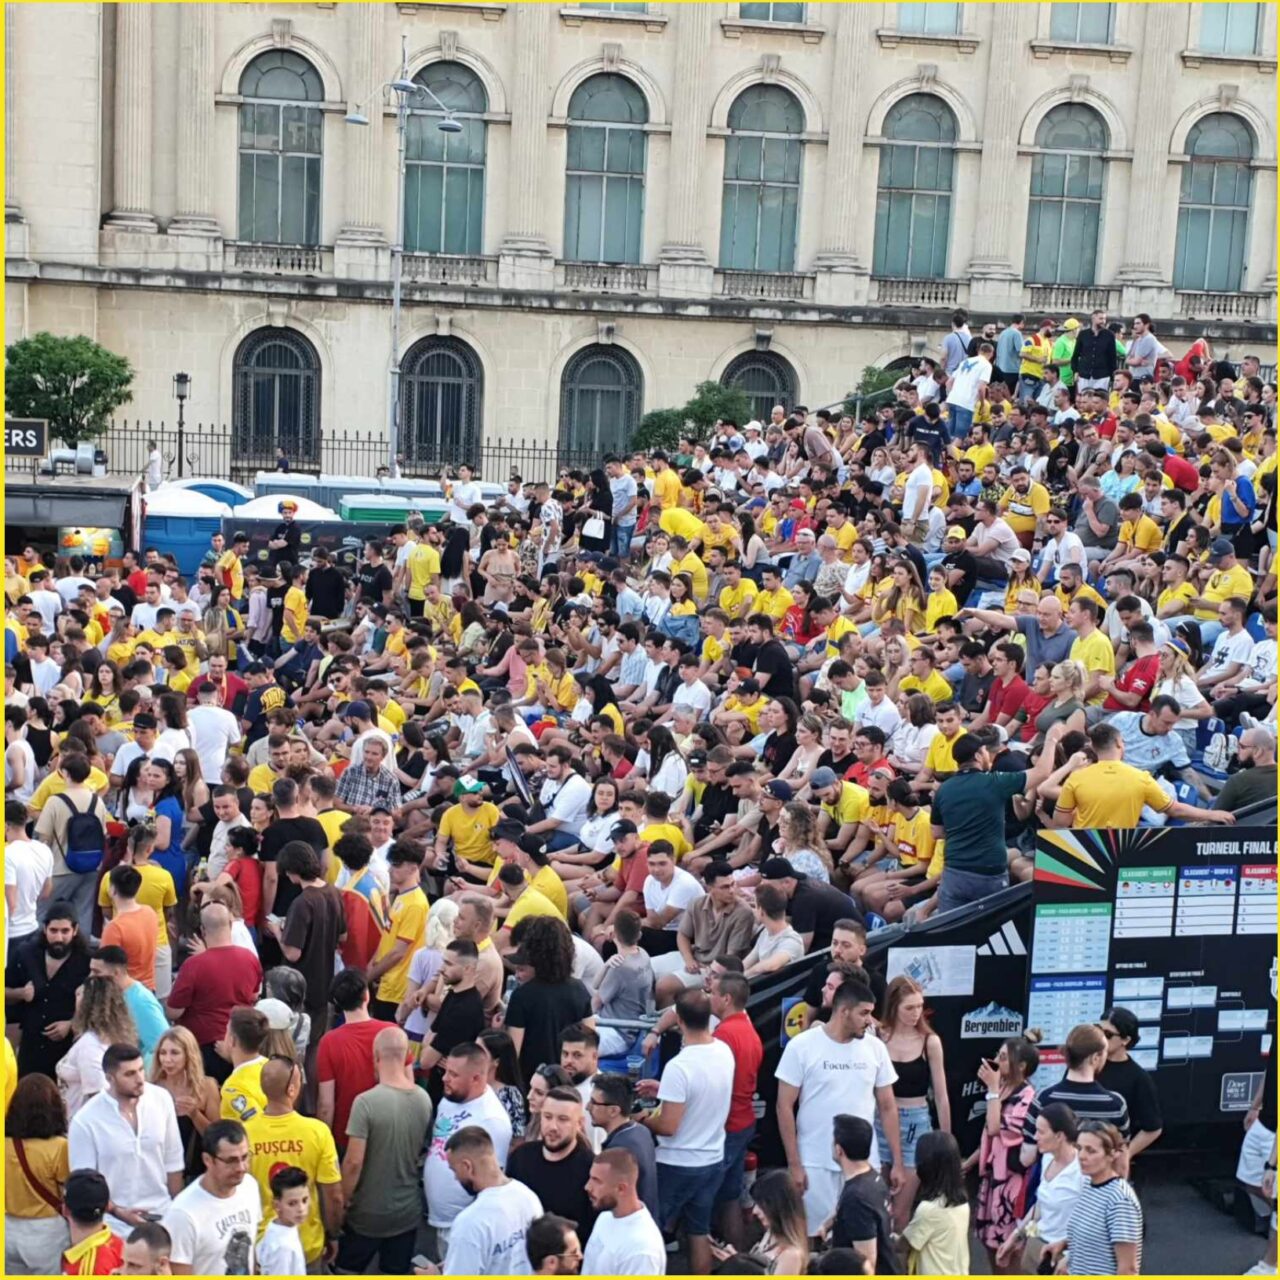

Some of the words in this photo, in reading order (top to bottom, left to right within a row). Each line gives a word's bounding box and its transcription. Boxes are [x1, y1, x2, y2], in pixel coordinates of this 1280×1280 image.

[1196, 841, 1241, 856] TURNEUL
[1243, 840, 1273, 854] FINAL
[964, 1018, 1021, 1034] Bergenbier
